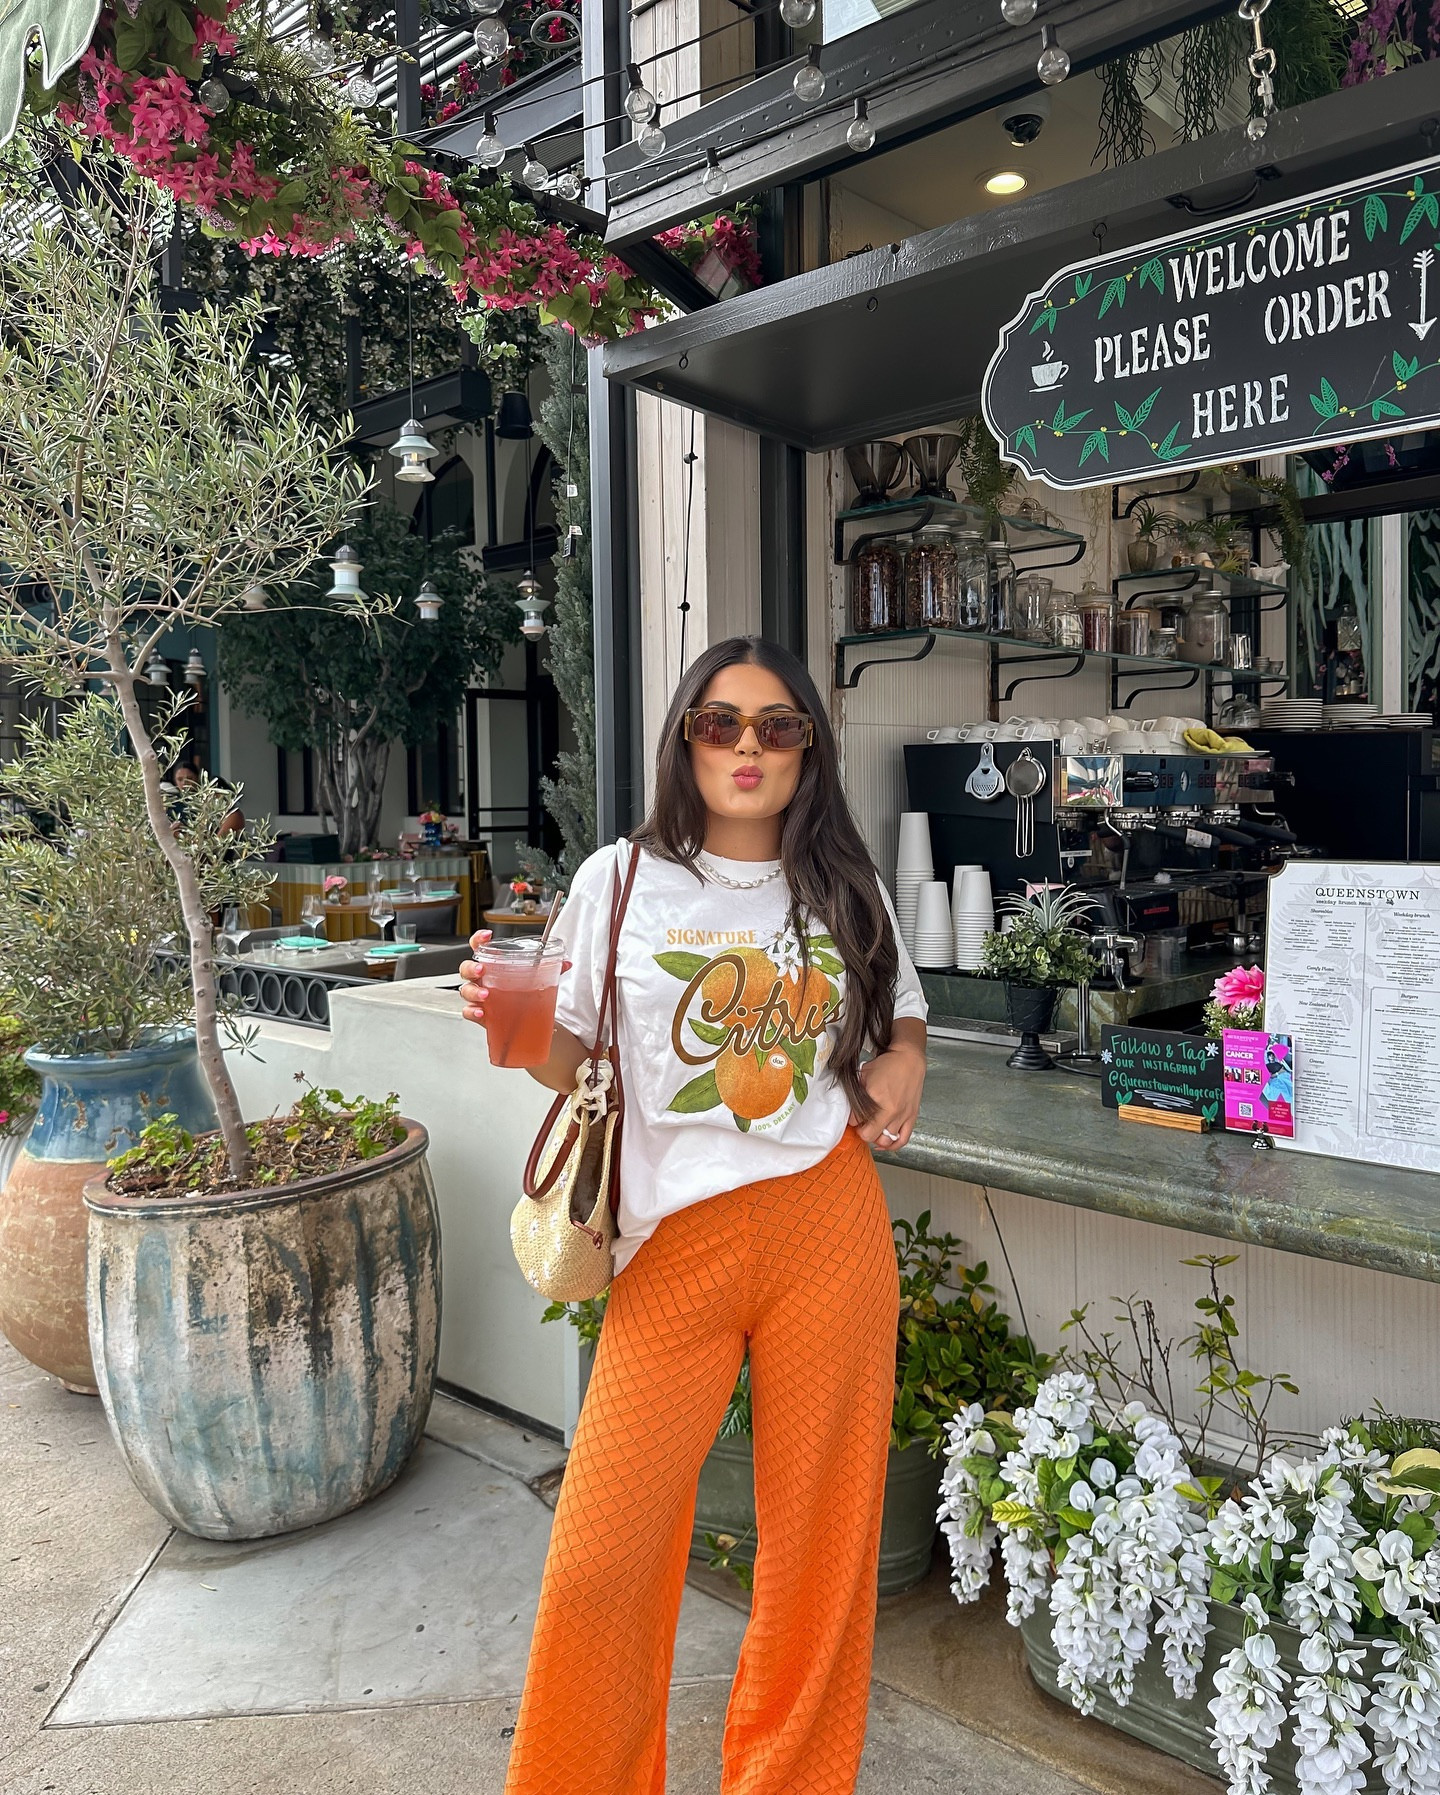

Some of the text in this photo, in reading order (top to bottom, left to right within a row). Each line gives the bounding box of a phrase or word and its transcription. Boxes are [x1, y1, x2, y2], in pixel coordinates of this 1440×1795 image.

[1168, 210, 1350, 303] WELCOME
[1094, 270, 1392, 384] PLEASE ORDER
[1191, 374, 1290, 439] HERE
[1315, 888, 1420, 900] QUEENSTOWN
[666, 928, 757, 945] SIGNATURE
[671, 953, 845, 1066] Citrus
[1111, 1034, 1160, 1056] Follow
[1165, 1044, 1174, 1058] &
[1177, 1041, 1214, 1071] Tag
[1115, 1058, 1197, 1075] OUR INSTAGRAM
[1225, 1050, 1254, 1059] CANCER
[755, 1102, 796, 1131] 100% DREAMY
